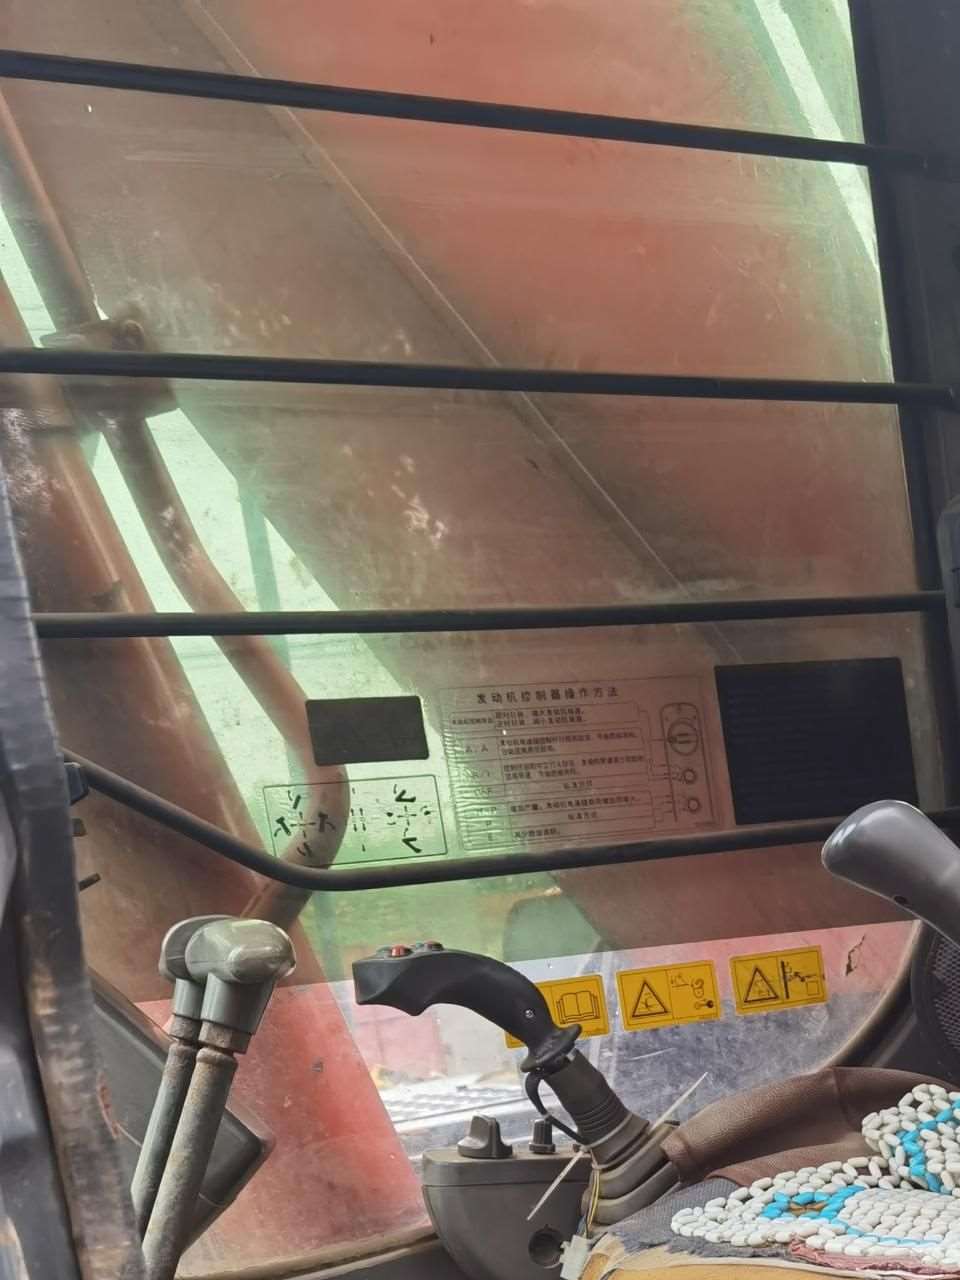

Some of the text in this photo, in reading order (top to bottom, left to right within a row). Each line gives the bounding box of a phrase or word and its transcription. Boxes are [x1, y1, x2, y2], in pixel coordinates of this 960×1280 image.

[476, 687, 619, 704] 发动机控制器操作方法
